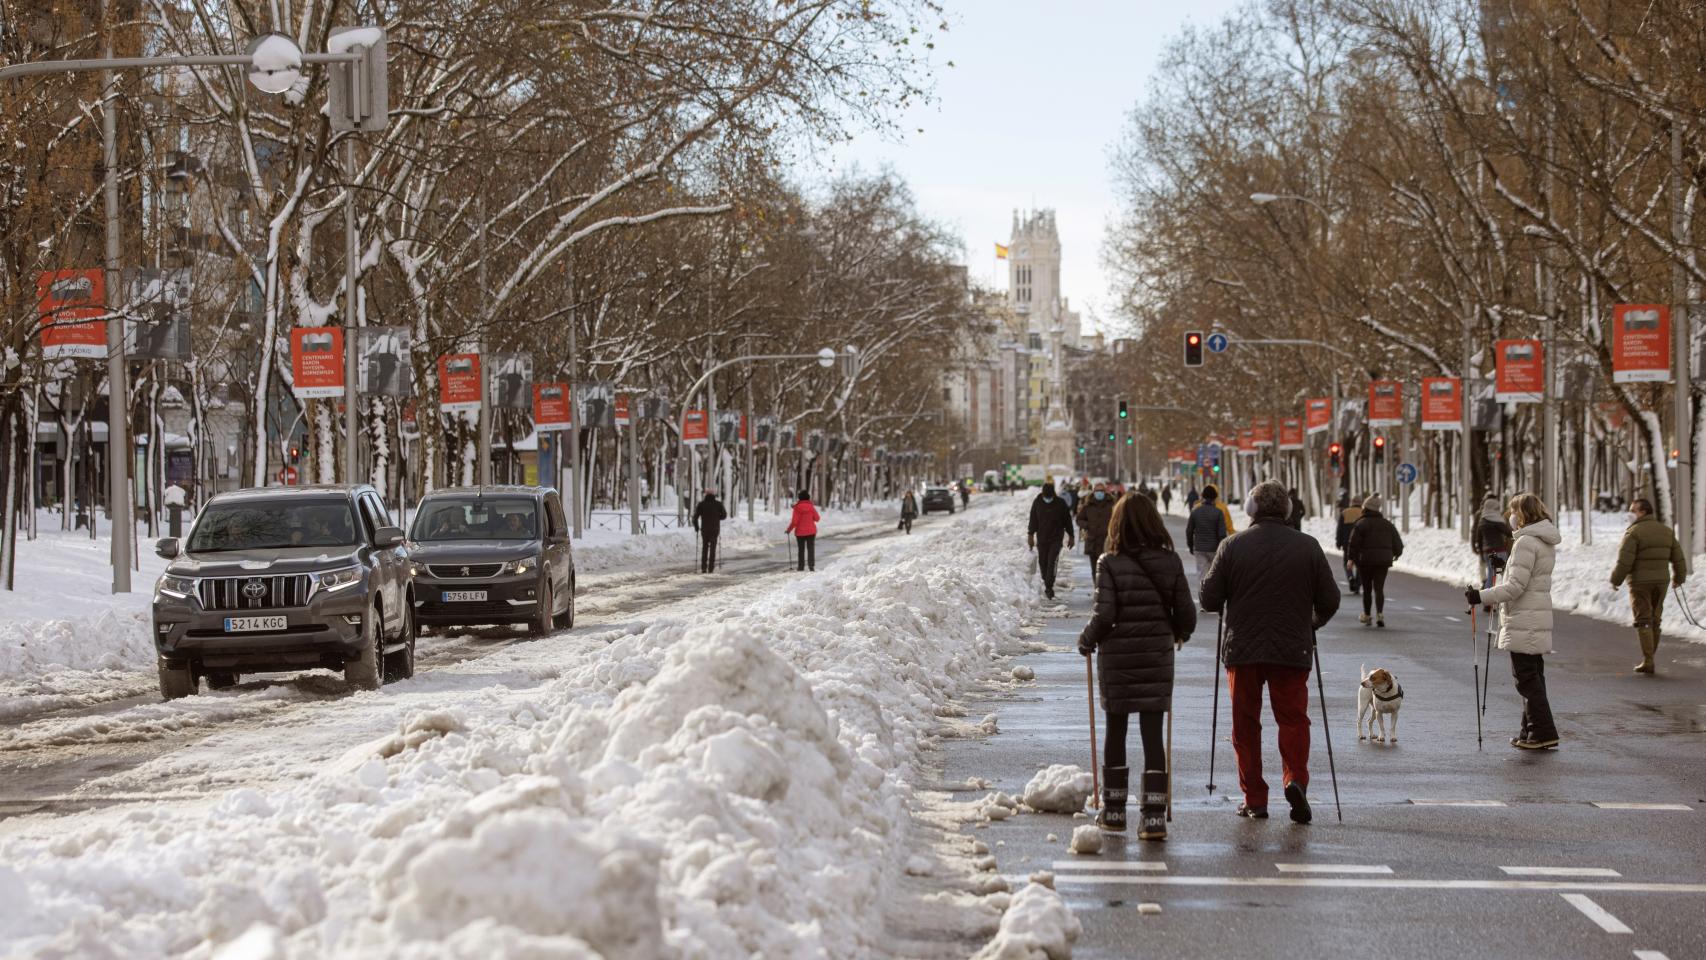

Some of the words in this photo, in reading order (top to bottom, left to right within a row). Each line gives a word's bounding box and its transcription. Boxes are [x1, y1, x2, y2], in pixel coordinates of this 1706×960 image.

[448, 592, 468, 601] 5756
[469, 592, 485, 601] LFV
[232, 618, 259, 630] 5214
[263, 617, 284, 629] KGC
